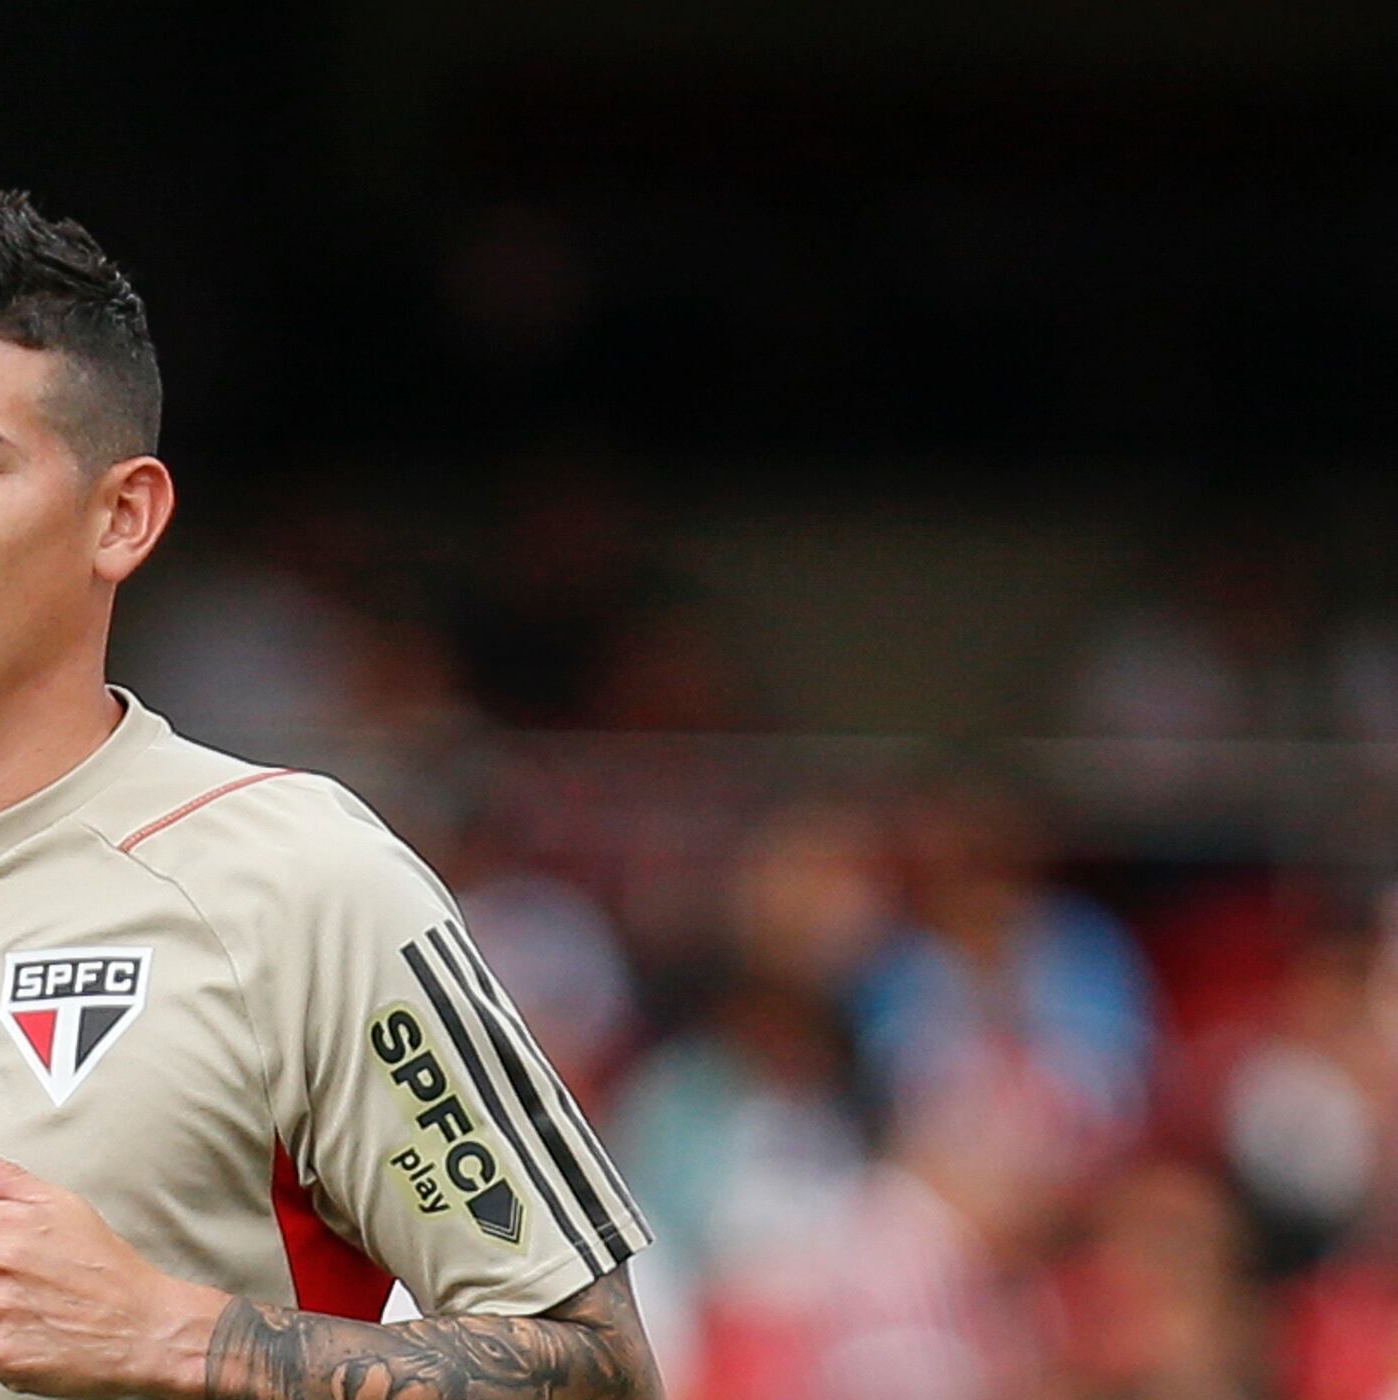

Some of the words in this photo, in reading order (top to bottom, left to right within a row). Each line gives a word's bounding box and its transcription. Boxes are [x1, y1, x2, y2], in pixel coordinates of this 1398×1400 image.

[15, 961, 135, 998] SPFC
[370, 1009, 496, 1194] SPFC
[390, 1147, 451, 1216] play
